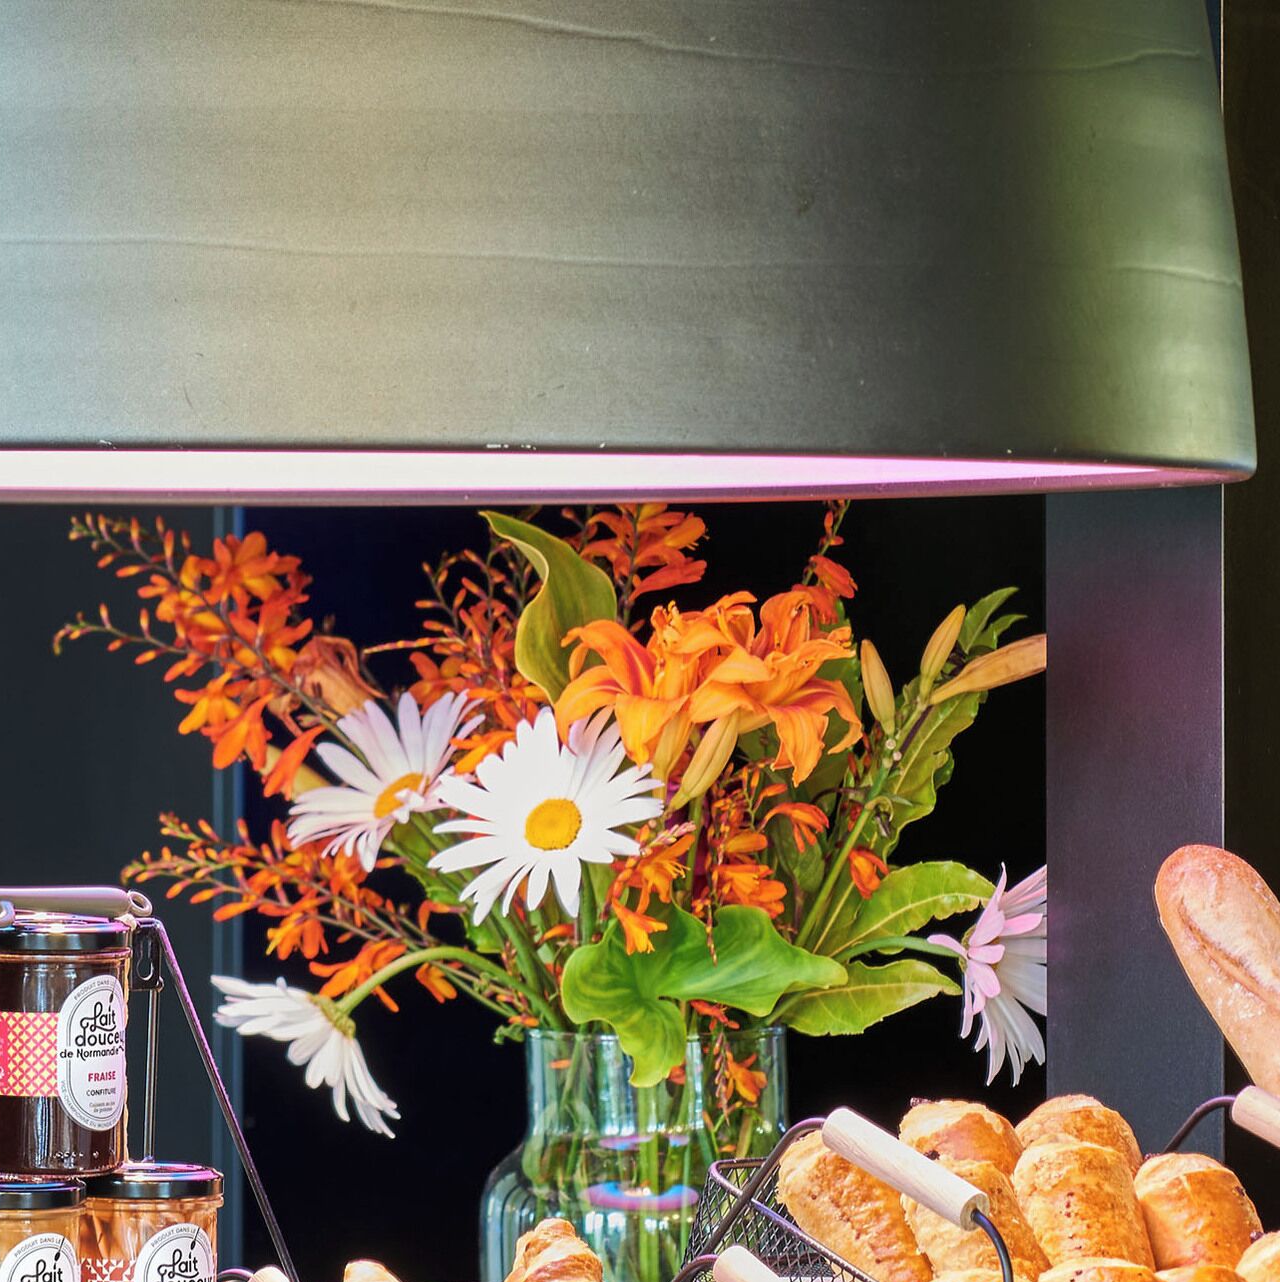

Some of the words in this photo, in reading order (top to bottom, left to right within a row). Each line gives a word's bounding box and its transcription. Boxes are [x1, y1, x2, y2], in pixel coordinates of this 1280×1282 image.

[80, 1001, 116, 1032] Lait
[60, 1048, 73, 1058] de
[76, 1046, 119, 1061] Normandie
[88, 1071, 116, 1082] FRAISE
[158, 1249, 199, 1279] Lait
